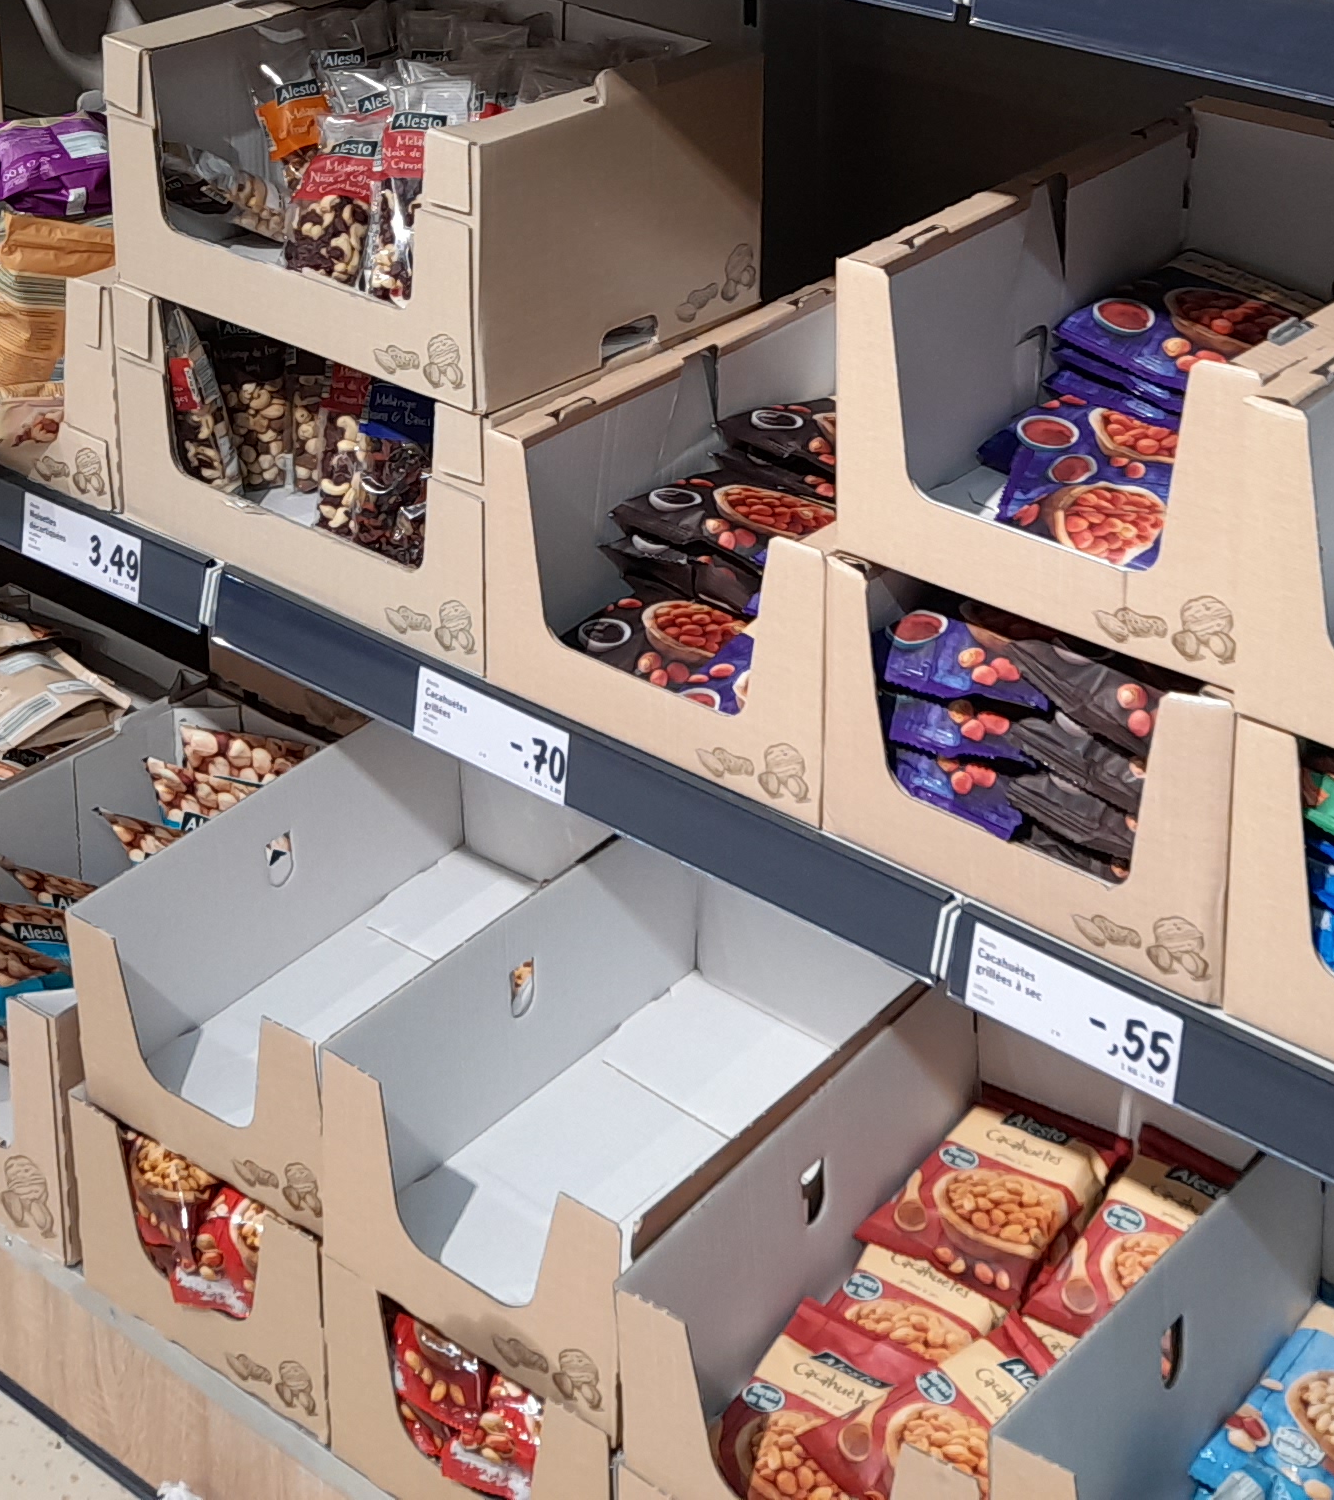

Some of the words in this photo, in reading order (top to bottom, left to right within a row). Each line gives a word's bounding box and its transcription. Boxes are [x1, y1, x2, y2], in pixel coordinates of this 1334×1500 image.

[323, 52, 361, 67] Alesto
[280, 83, 317, 100] Alesto
[363, 94, 390, 112] Ales
[395, 114, 442, 128] Alesto
[89, 534, 139, 582] 3,49
[19, 924, 64, 942] Alesto
[977, 947, 1036, 983] Cacahuètes
[975, 964, 1012, 988] grillées
[1025, 985, 1042, 1002] sec
[1007, 1113, 1067, 1143] Alesto
